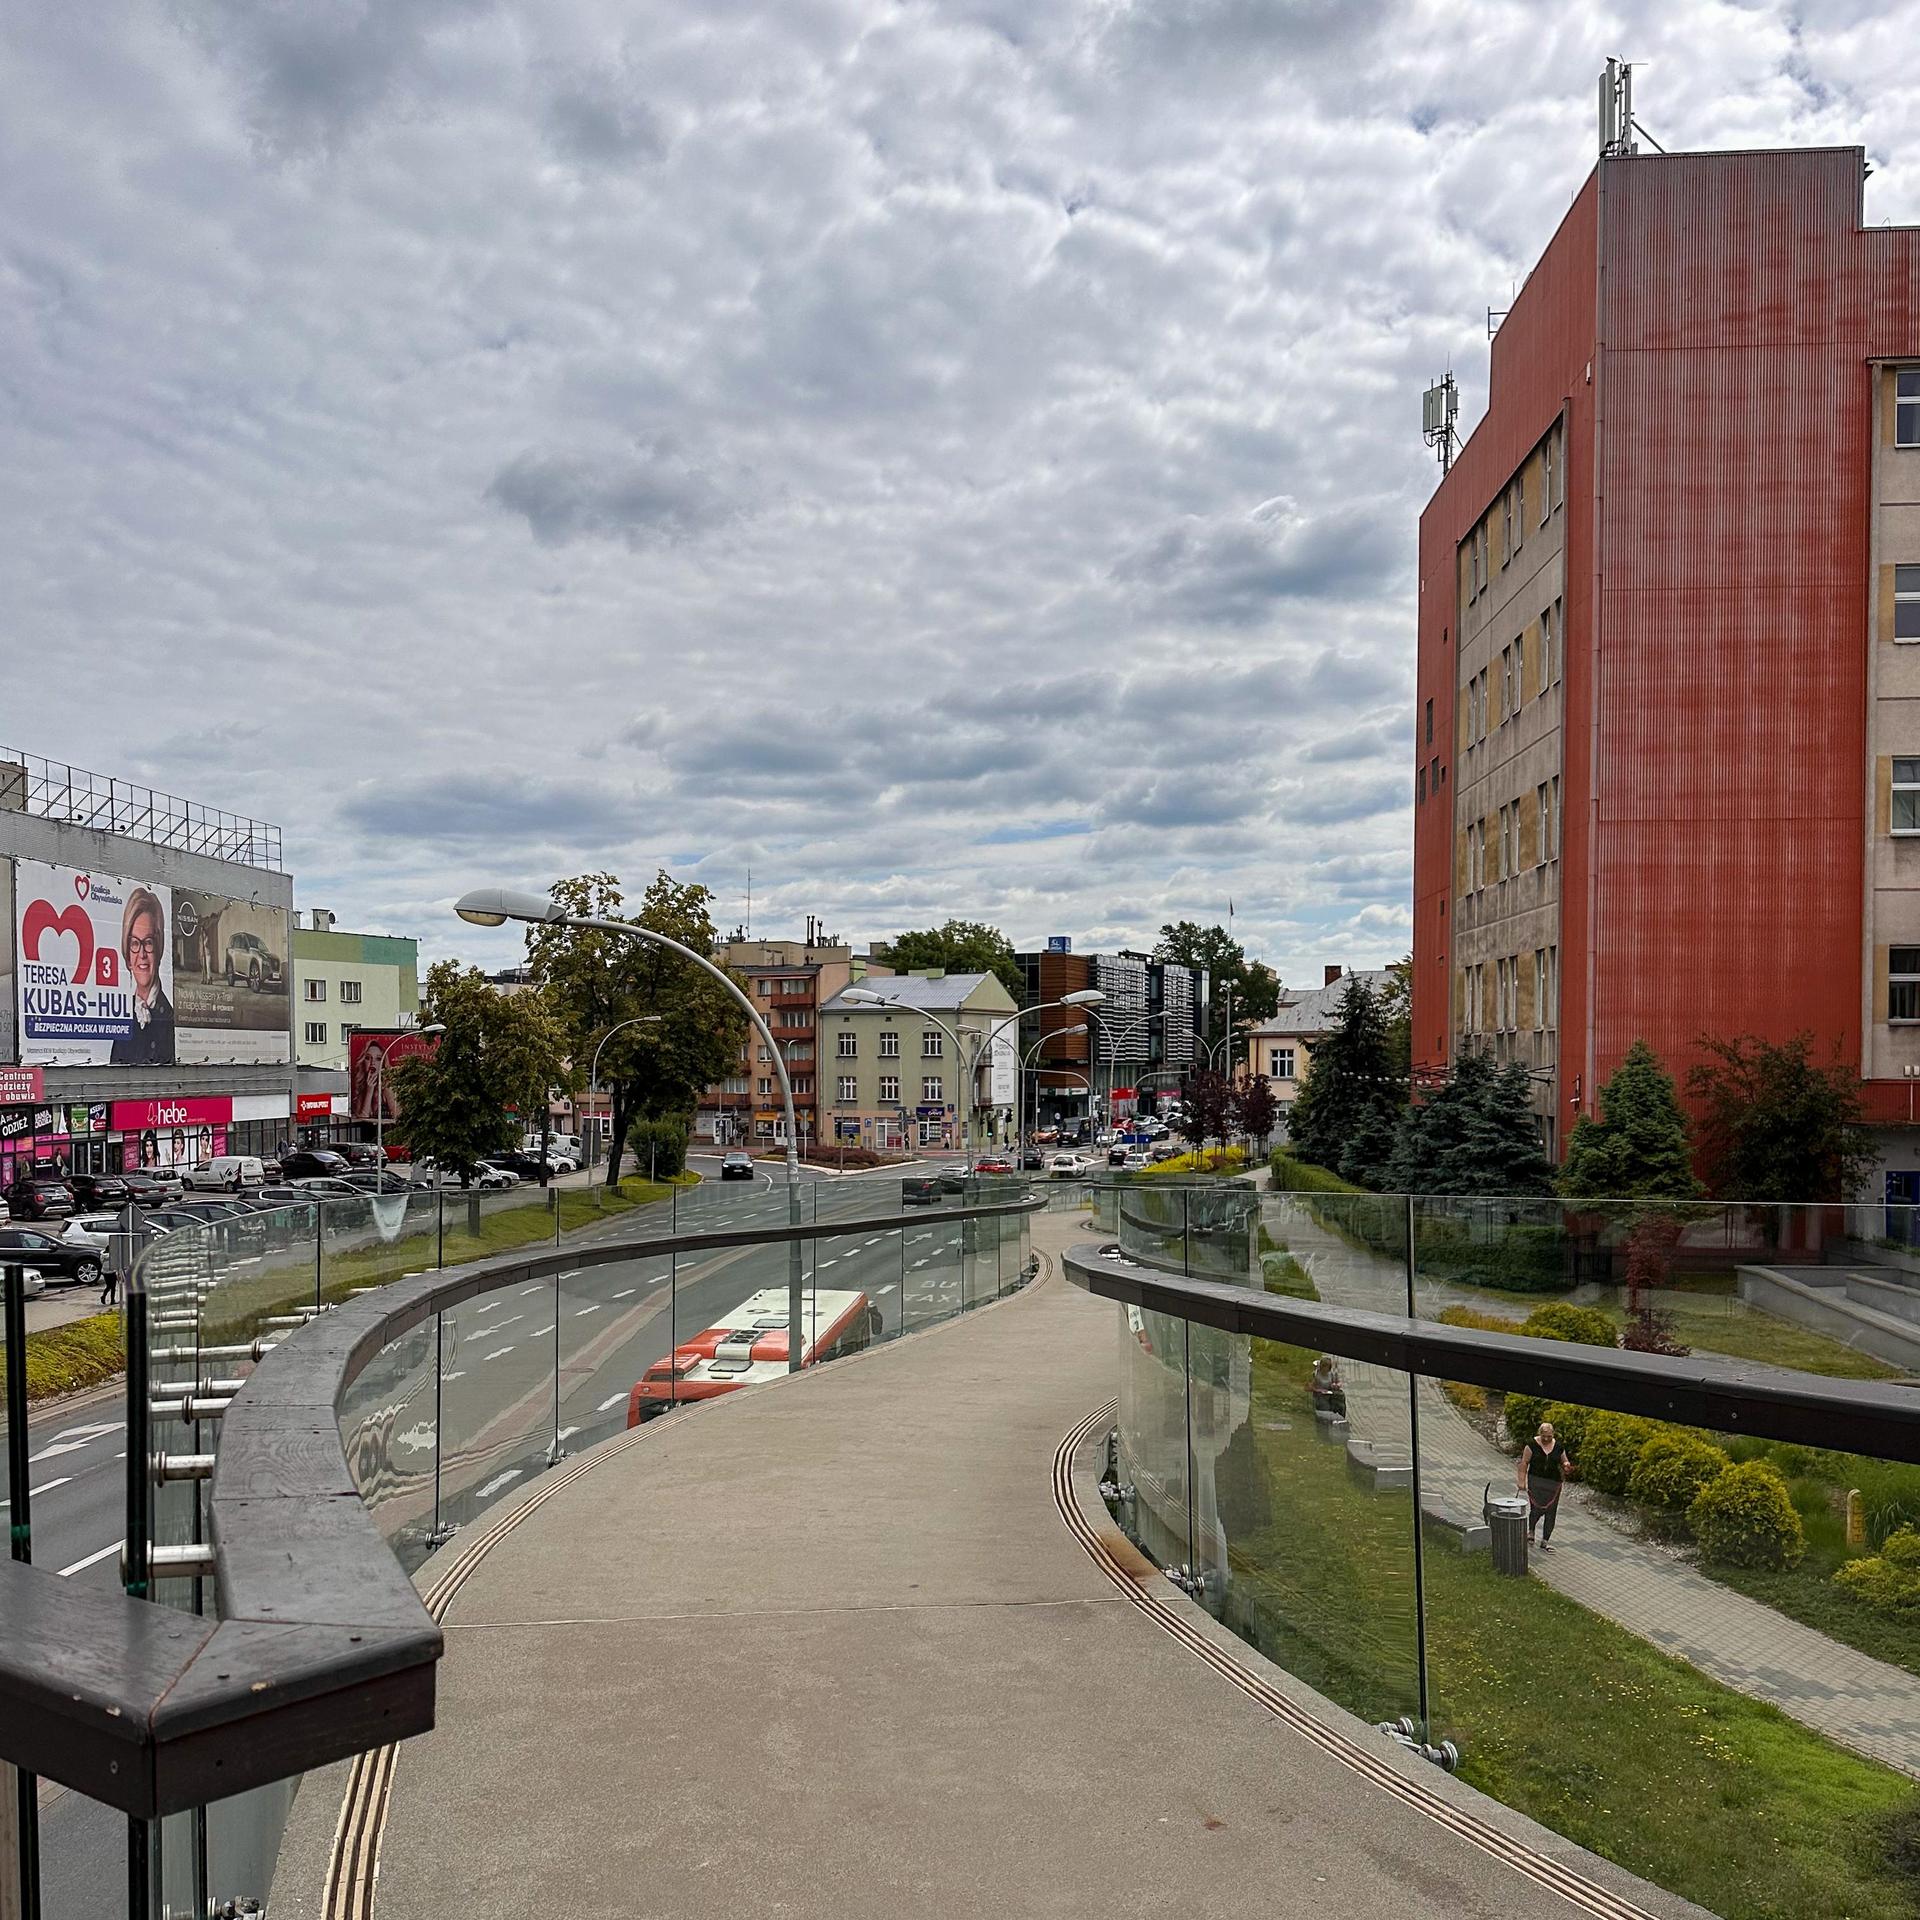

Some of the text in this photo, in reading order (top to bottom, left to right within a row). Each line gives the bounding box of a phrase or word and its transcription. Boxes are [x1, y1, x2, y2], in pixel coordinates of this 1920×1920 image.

[177, 915, 198, 923] NISSAN
[24, 964, 67, 986] TERESA
[103, 956, 111, 978] 3
[24, 987, 131, 1018] KUBAS-HUL
[34, 1022, 130, 1034] BEZPIECZNA POLSKA W EUROPIE
[6, 1092, 35, 1101] obuwia
[158, 1101, 187, 1124] hebe
